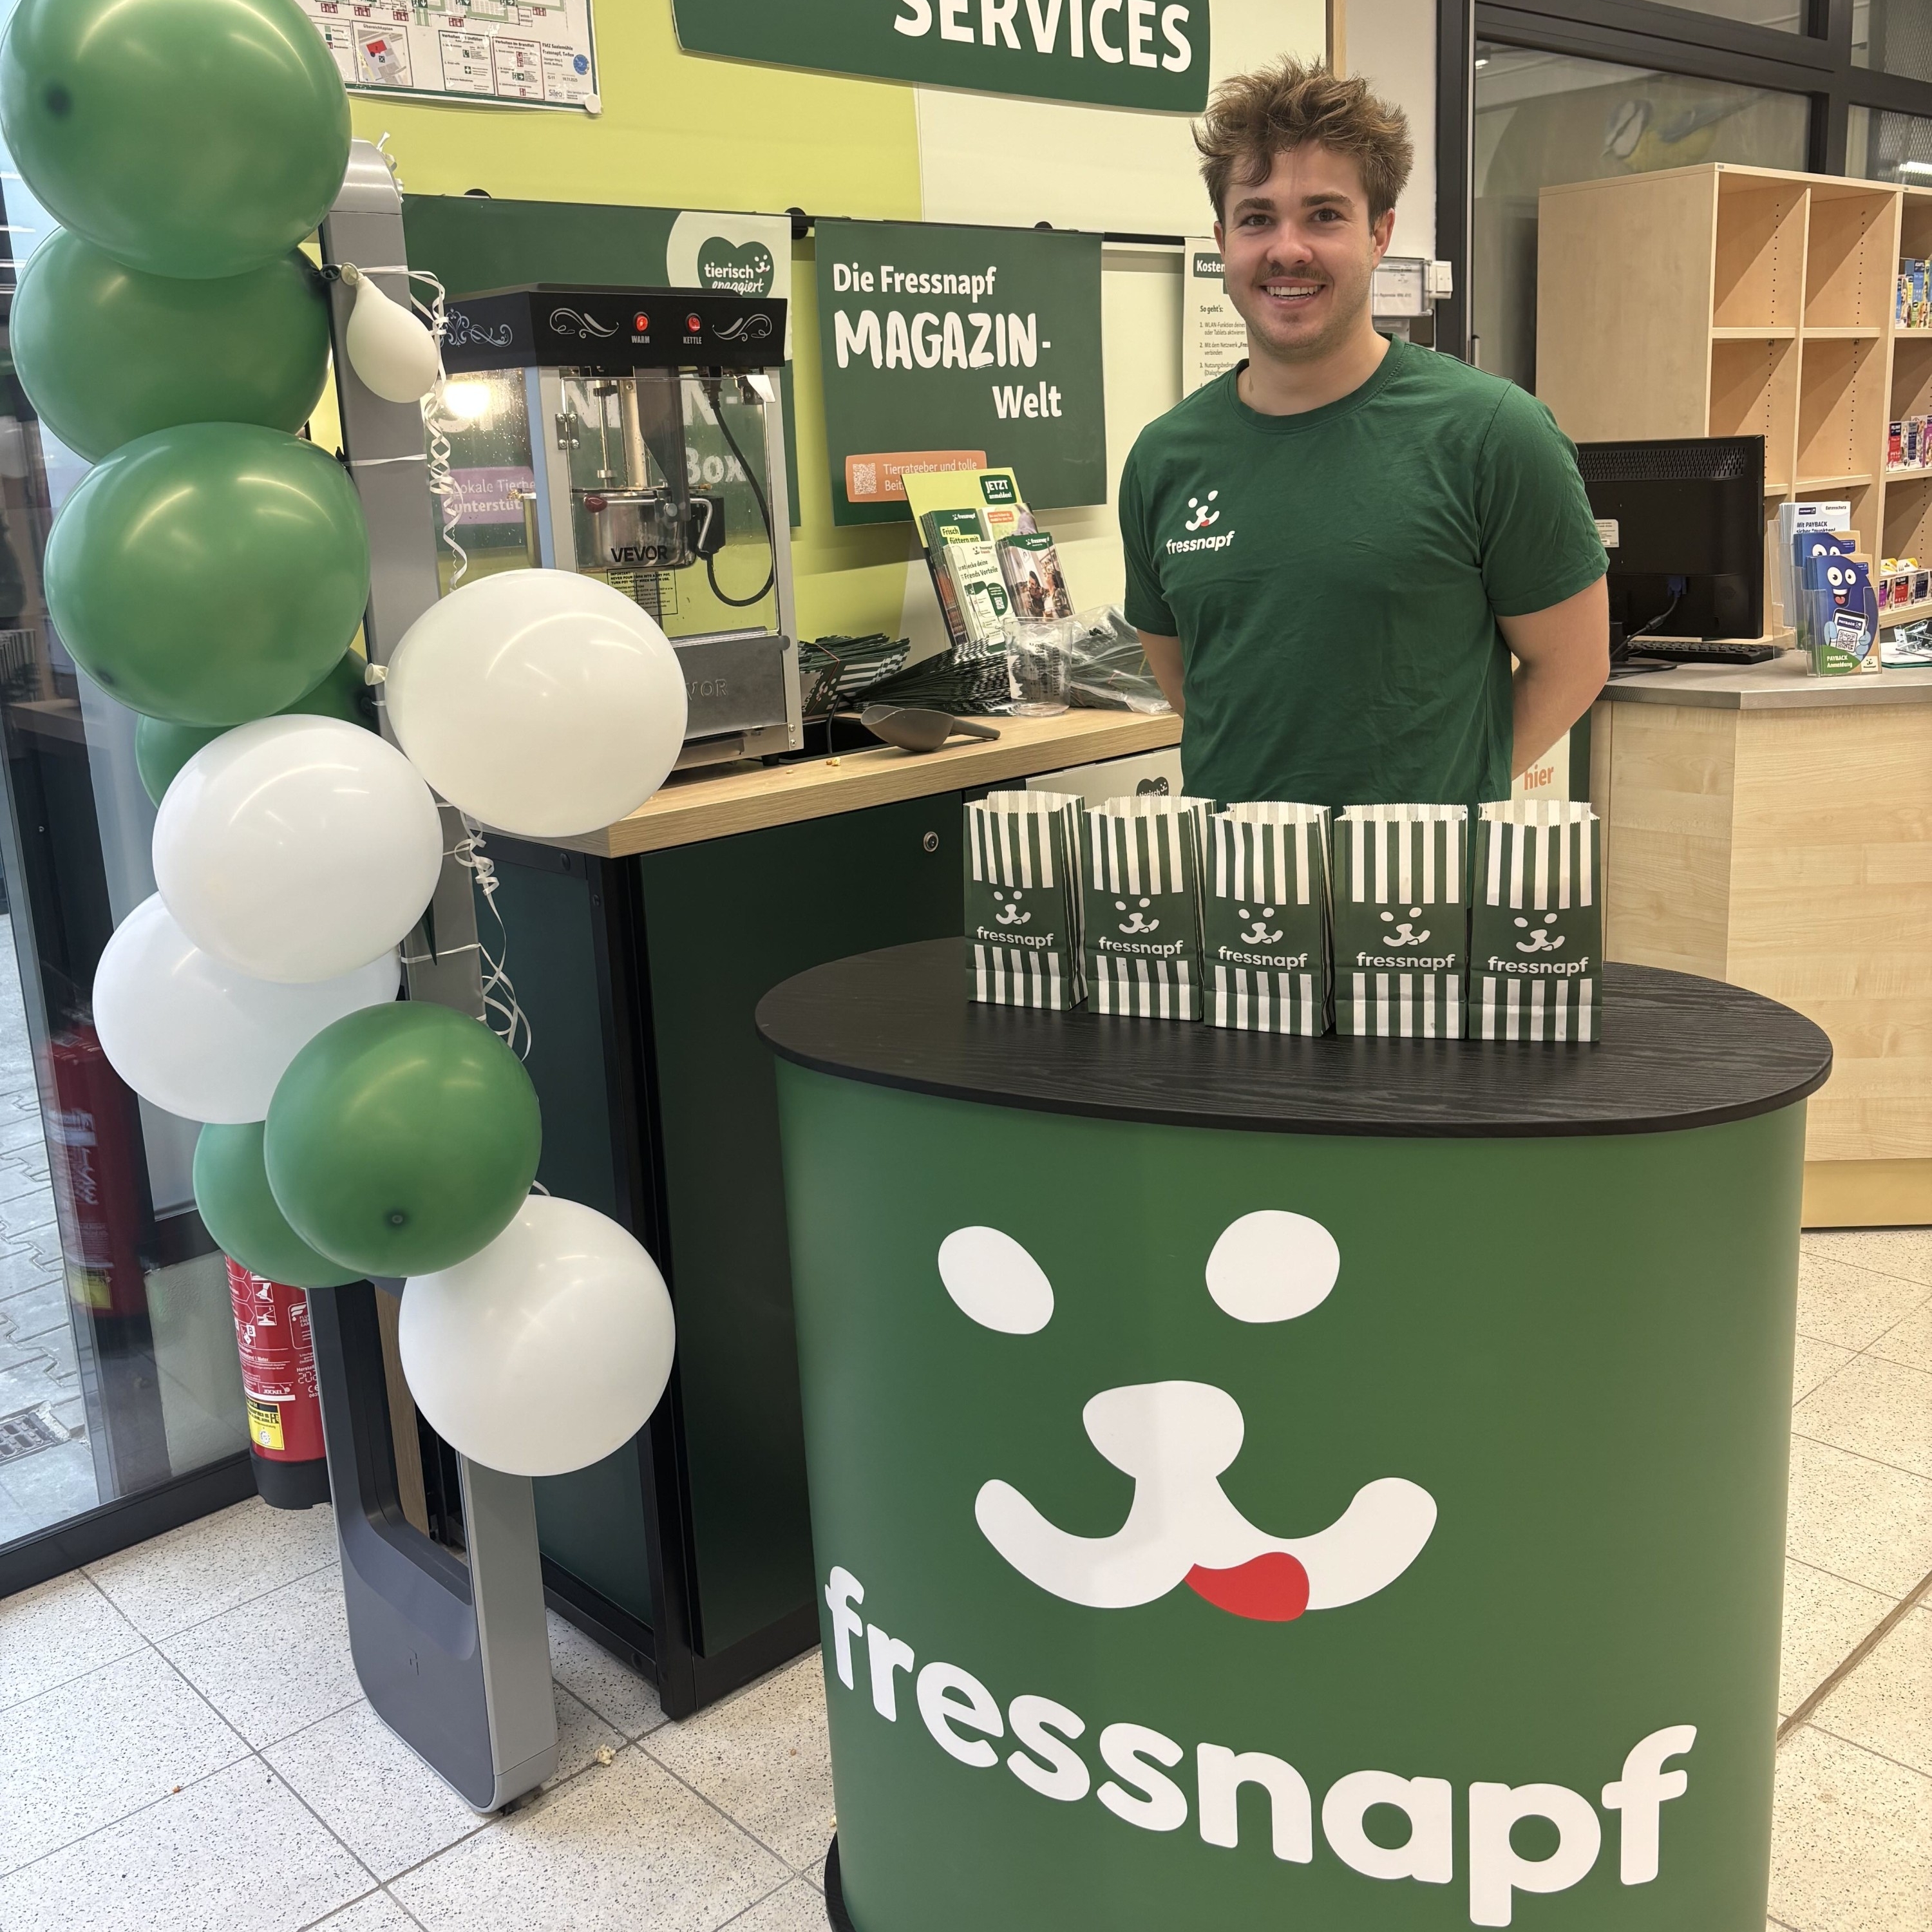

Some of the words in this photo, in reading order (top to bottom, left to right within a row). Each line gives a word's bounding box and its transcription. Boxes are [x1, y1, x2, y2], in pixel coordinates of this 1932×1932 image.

[894, 0, 1192, 73] SERVICES
[704, 261, 754, 279] tierisch
[833, 262, 874, 292] Die
[880, 265, 997, 303] Fressnapf
[631, 336, 650, 344] WARM
[683, 336, 702, 345] KETTLE
[834, 309, 1051, 370] MAGAZIN-
[992, 381, 1063, 419] Welt
[883, 460, 938, 475] Tierratgeber
[940, 459, 956, 471] und
[958, 458, 978, 471] tolle
[885, 480, 905, 491] Beit
[985, 480, 1009, 494] JETZT
[942, 526, 960, 535] Frisch
[1166, 530, 1236, 555] fressnapf
[611, 545, 668, 563] VEVOR
[1524, 764, 1554, 791] hier
[976, 926, 1054, 949] fressnapf
[1098, 936, 1184, 958] fressnapf
[1218, 945, 1308, 971] fressnapf
[1356, 951, 1456, 971] fressnapf
[1488, 956, 1589, 977] fressnapf
[249, 1327, 254, 1335] B
[825, 1565, 1698, 1928] fressnapf
